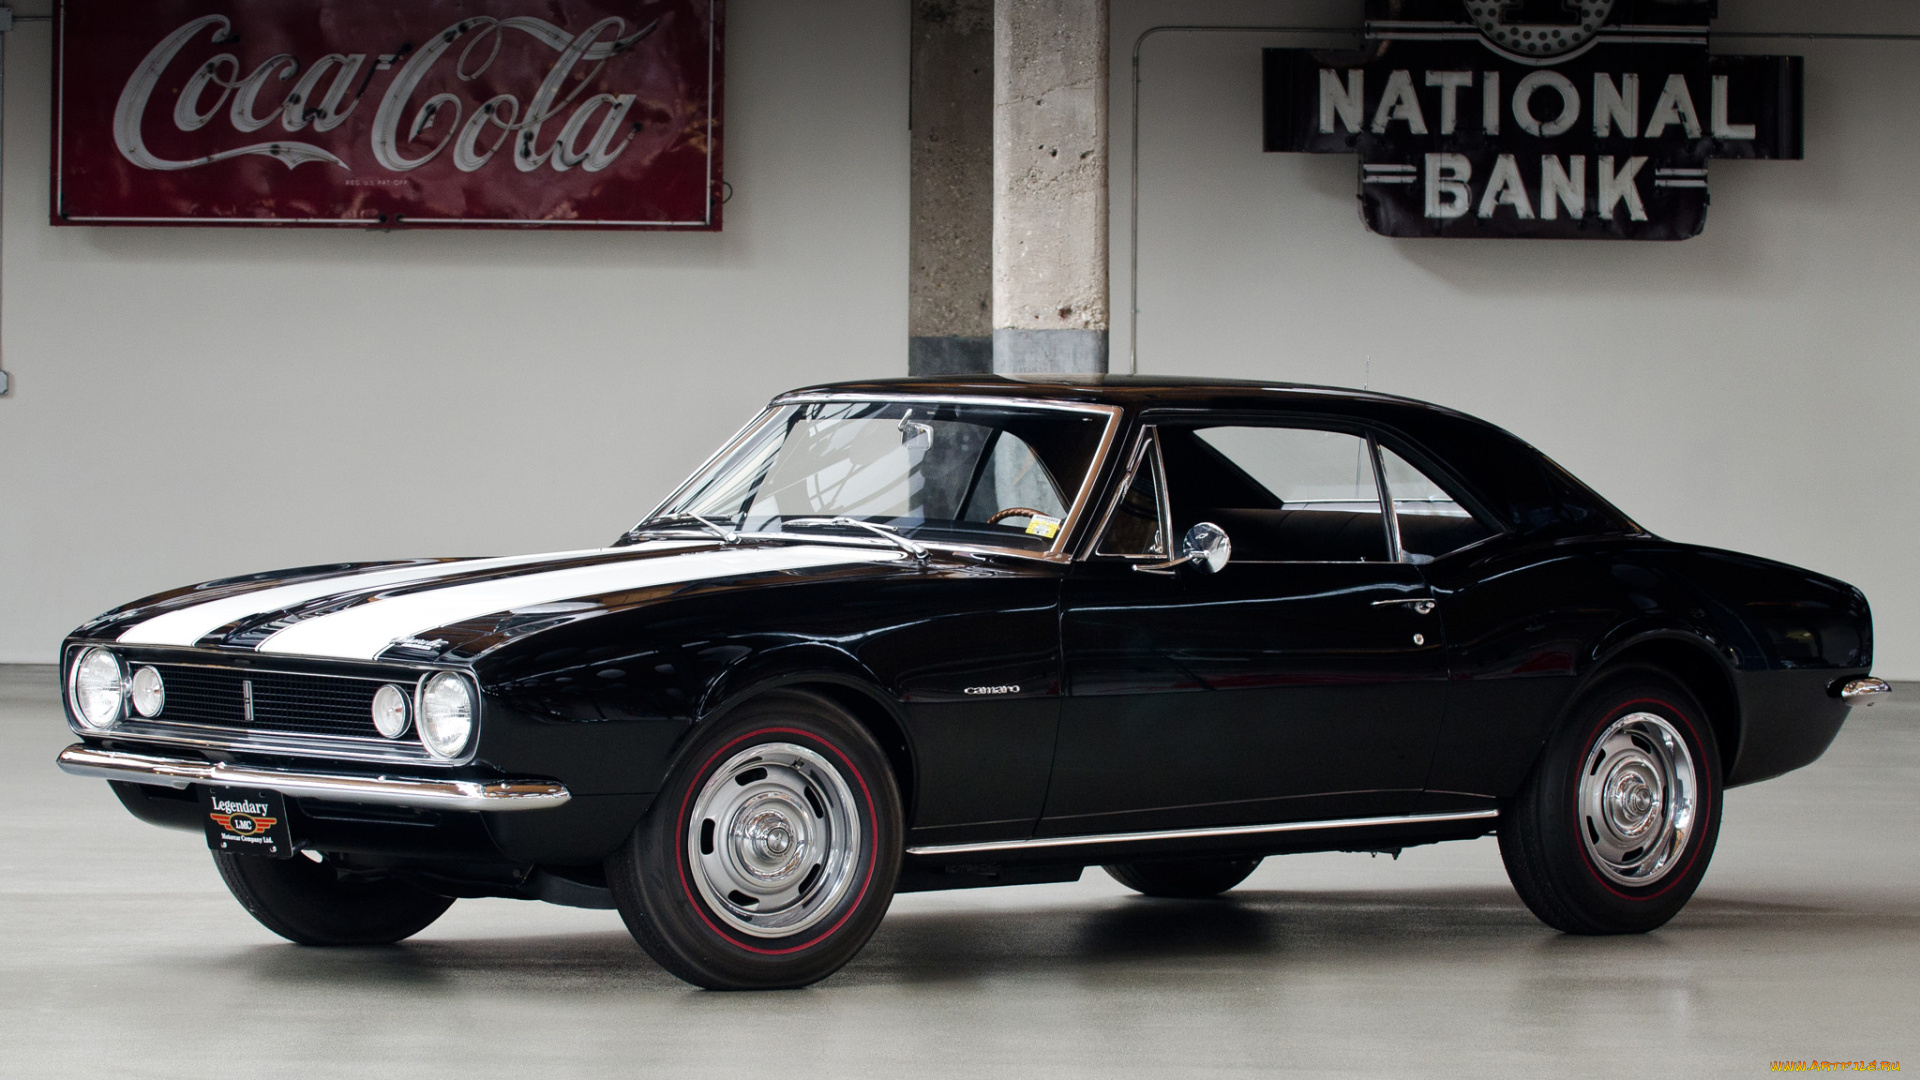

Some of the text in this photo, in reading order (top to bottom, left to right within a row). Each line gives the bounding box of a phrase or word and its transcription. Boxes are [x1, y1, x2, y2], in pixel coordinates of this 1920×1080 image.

[113, 14, 660, 173] Coca-Cola
[1318, 68, 1756, 140] NATIONAL
[1424, 152, 1649, 221] BANK
[211, 796, 268, 817] Legendary
[234, 819, 252, 830] LMC
